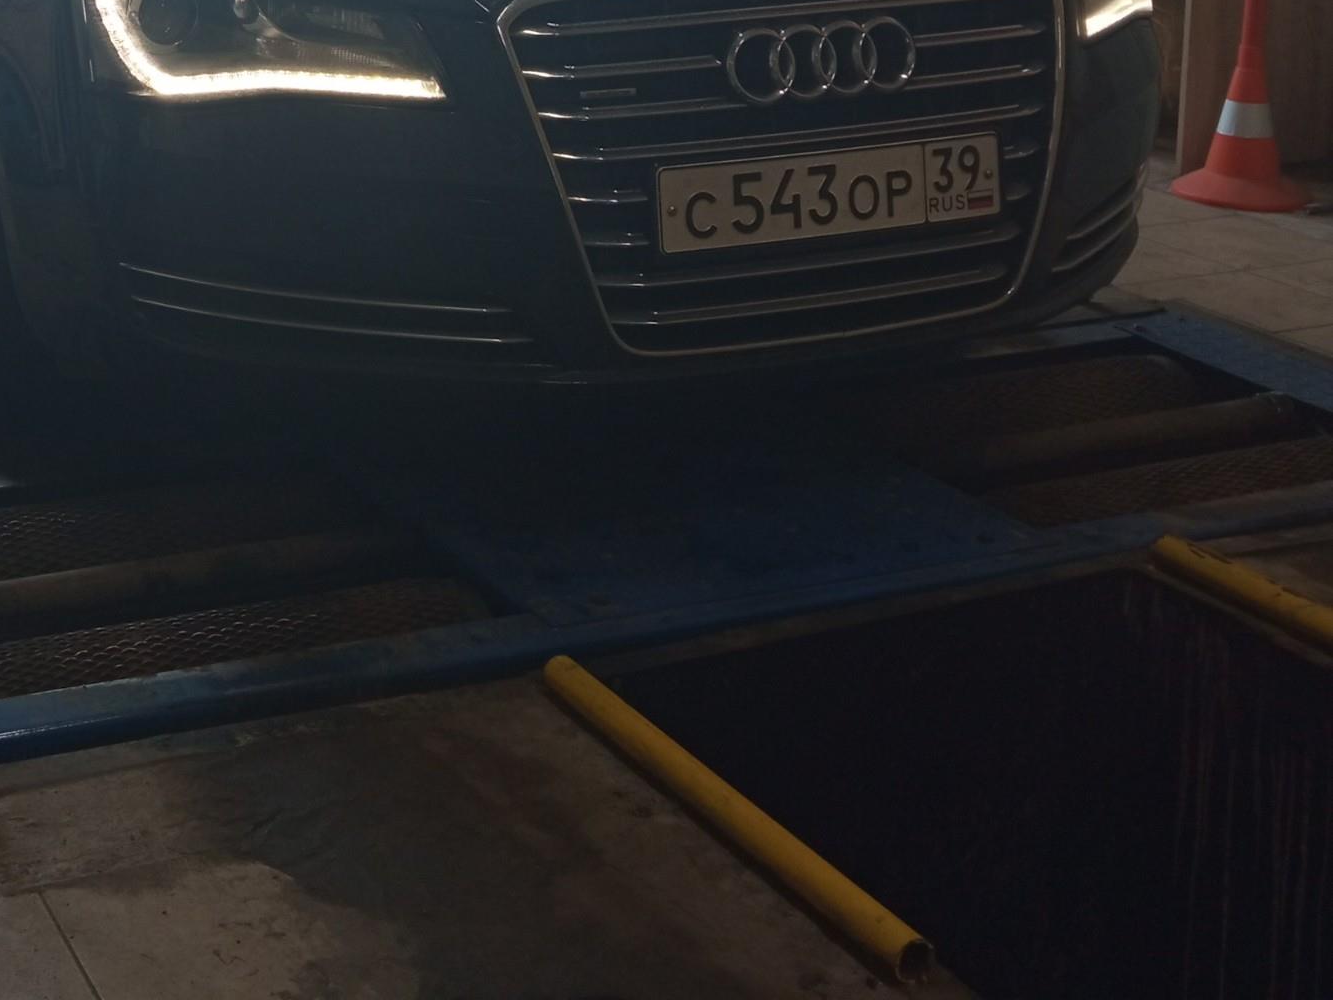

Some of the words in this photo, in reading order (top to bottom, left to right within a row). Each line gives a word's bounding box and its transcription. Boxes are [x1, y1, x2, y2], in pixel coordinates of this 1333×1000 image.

[932, 145, 981, 193] 39
[685, 164, 913, 239] С543ОР
[929, 193, 965, 213] RUS
